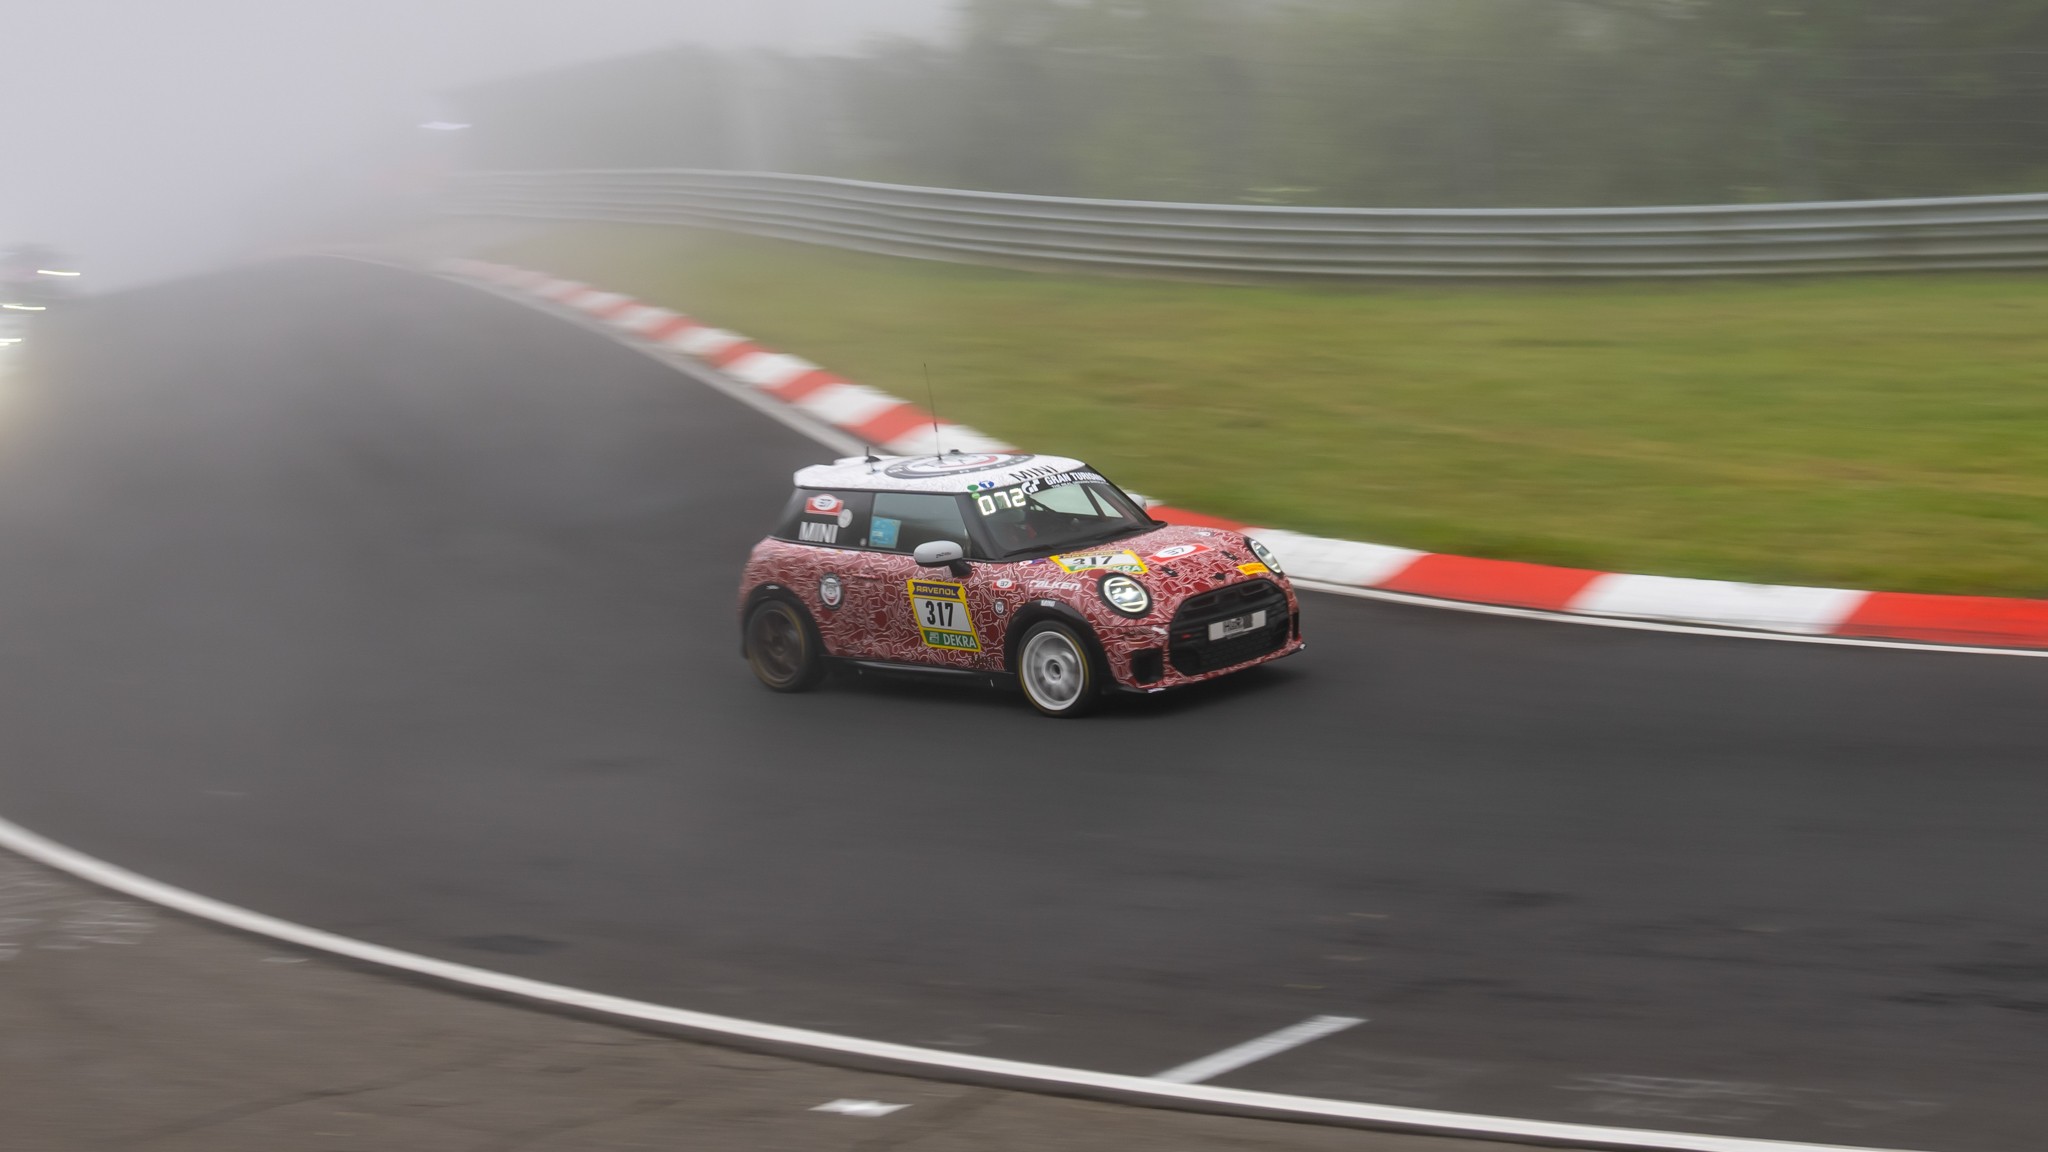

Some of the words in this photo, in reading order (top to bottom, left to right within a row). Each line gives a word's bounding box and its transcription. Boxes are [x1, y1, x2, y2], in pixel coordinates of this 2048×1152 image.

[1009, 465, 1058, 481] MINI
[1044, 473, 1072, 486] GRAN
[977, 488, 1026, 516] 072
[799, 521, 838, 543] MINI
[1072, 555, 1113, 566] 317
[916, 585, 956, 596] RAVENOL
[1030, 580, 1080, 591] FALKEN
[925, 600, 953, 627] 317
[943, 633, 977, 648] DEKRA
